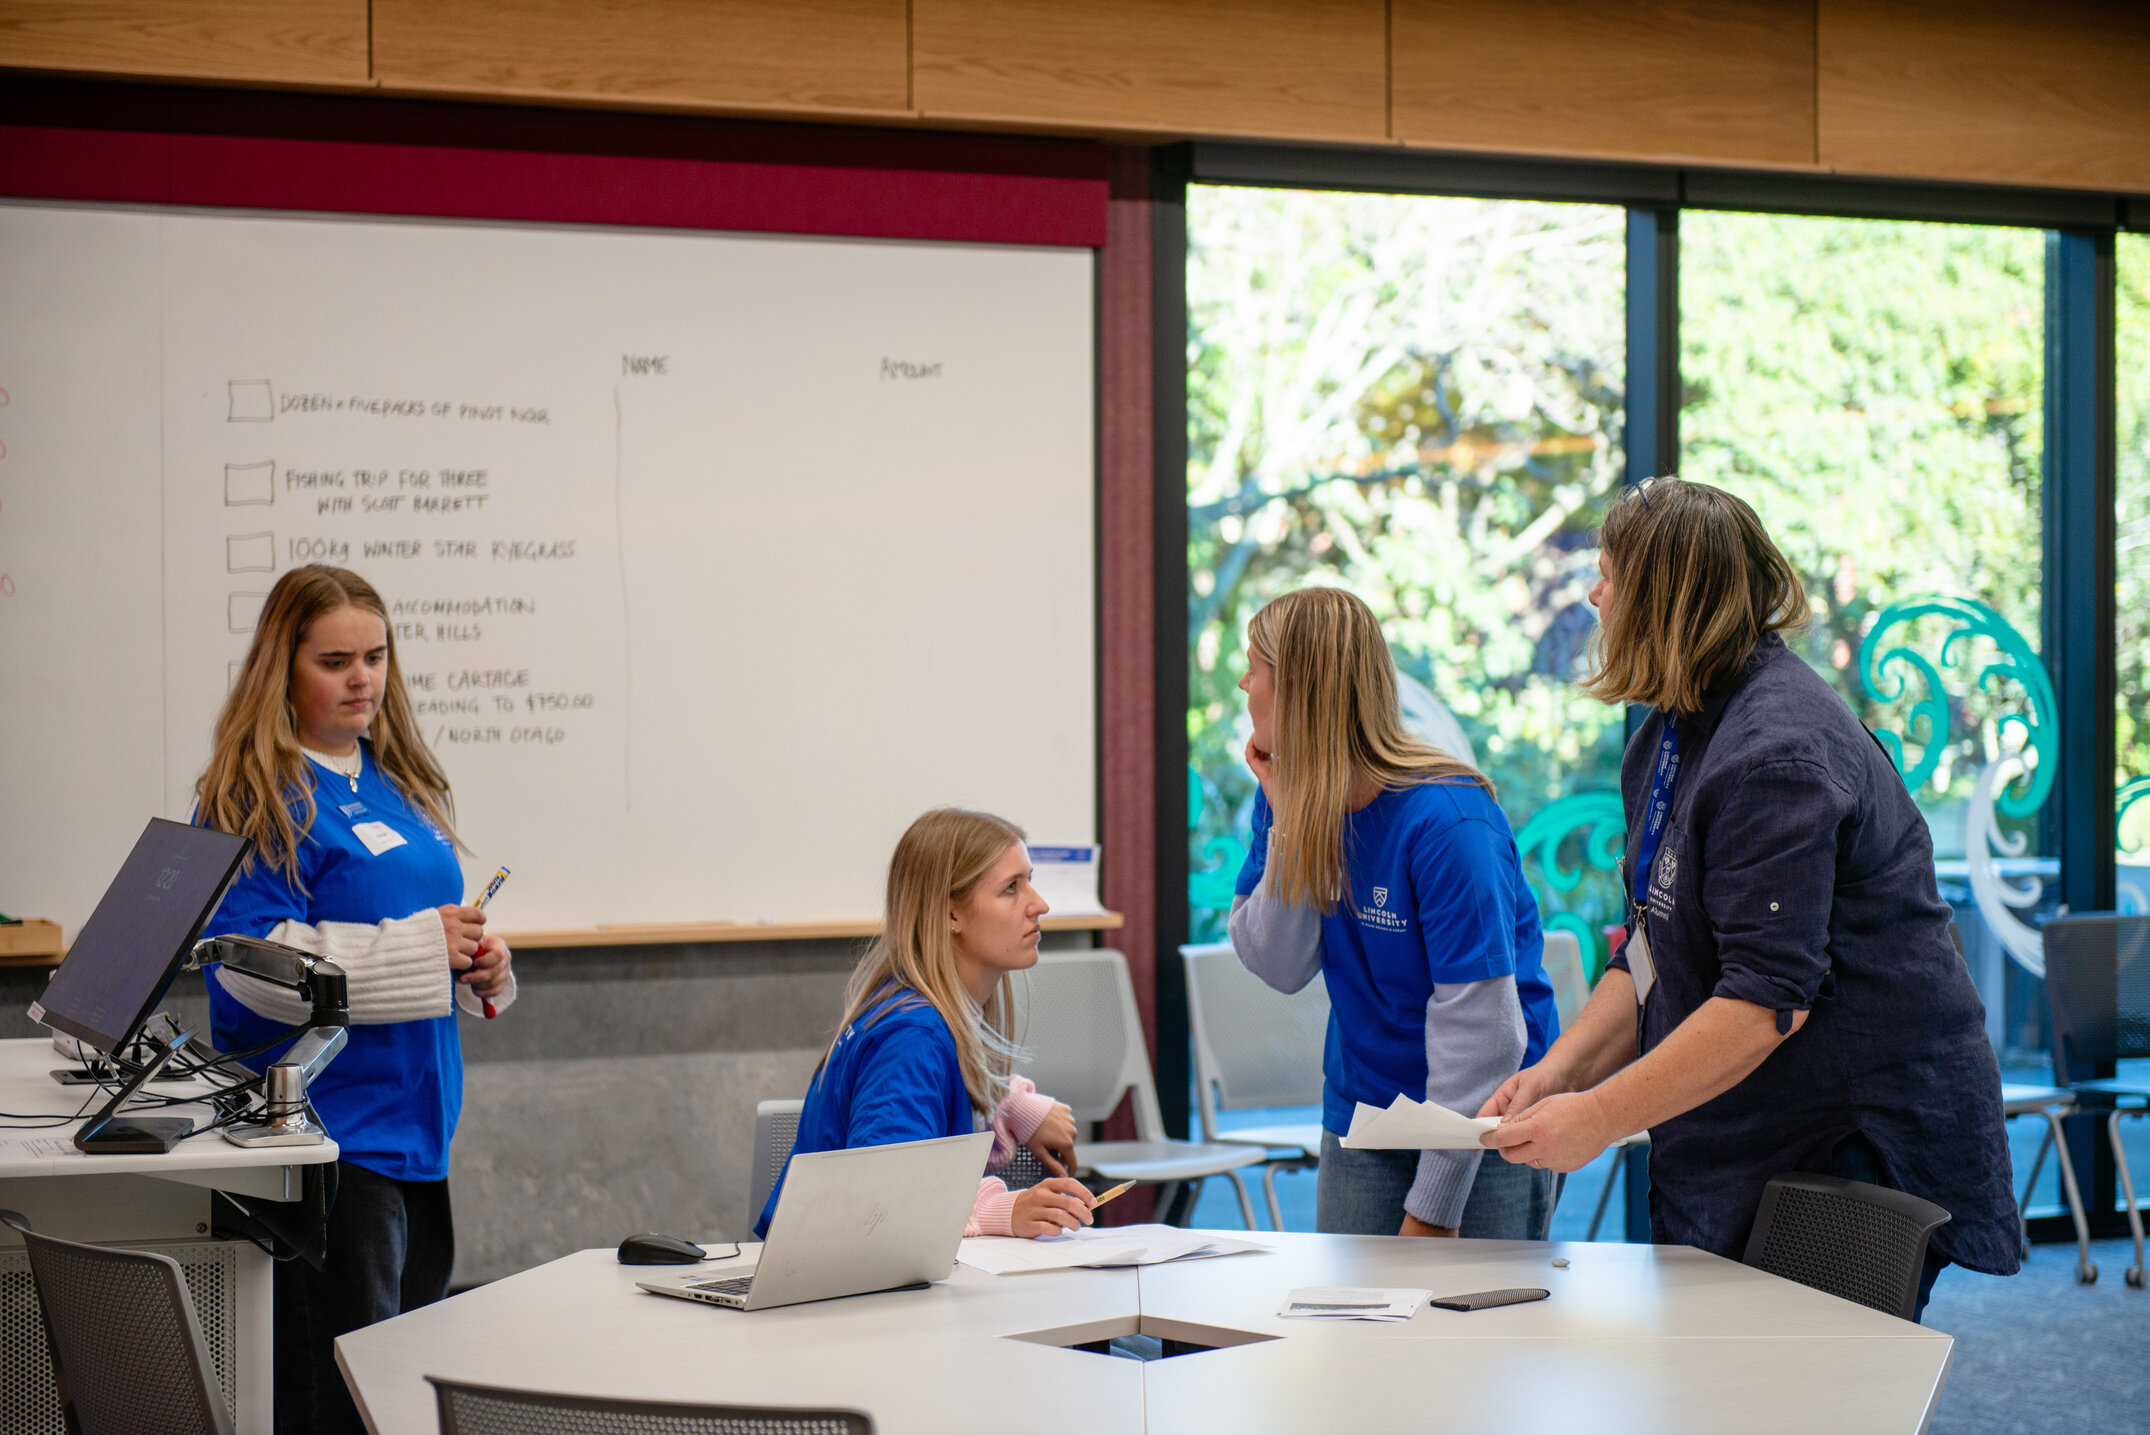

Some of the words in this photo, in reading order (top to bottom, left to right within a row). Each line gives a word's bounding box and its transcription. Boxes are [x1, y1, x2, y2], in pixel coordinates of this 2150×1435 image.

[621, 353, 671, 377] NAME
[880, 356, 944, 381] AMOUNT
[280, 393, 332, 414] DOZEN
[430, 401, 452, 419] OF
[460, 402, 504, 421] PINOT
[510, 405, 551, 425] NOIR
[286, 468, 345, 492] FISHING
[353, 468, 389, 488] TRIP
[399, 469, 431, 489] FOR
[439, 467, 488, 488] THREE
[317, 495, 352, 516] WITH
[361, 494, 407, 513] SCOTT
[413, 493, 490, 514] BARRETT
[363, 538, 422, 559] WINTER
[433, 538, 478, 559] STAR
[491, 538, 576, 562] RYEGRASS
[392, 596, 536, 616] ACCOMMODATION
[394, 620, 429, 642] TER
[437, 622, 482, 642] HILLS
[406, 671, 437, 692] IME
[447, 668, 529, 692] CARTAGE
[415, 695, 480, 715] EADING
[493, 694, 515, 714] TO
[510, 726, 566, 746] OTAGO
[1356, 911, 1408, 928] UNIVERSITY
[1363, 905, 1398, 920] LINCOLN
